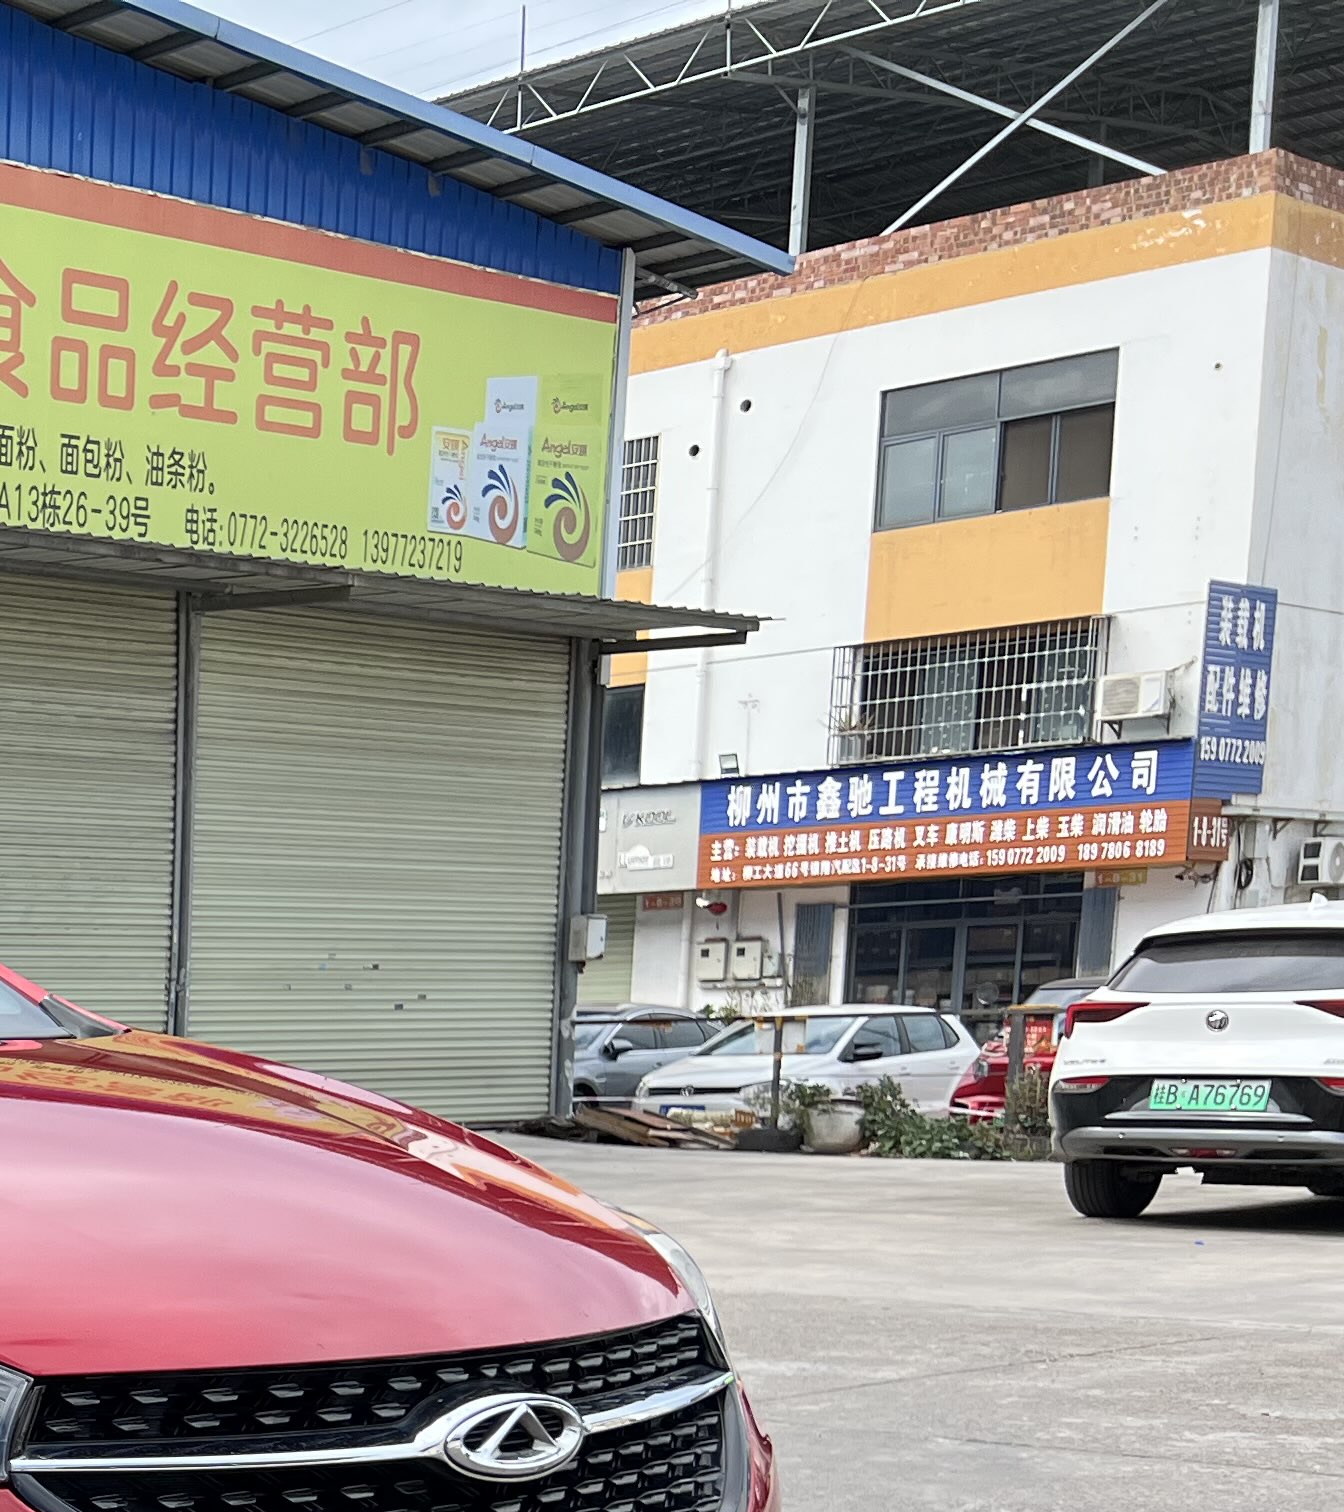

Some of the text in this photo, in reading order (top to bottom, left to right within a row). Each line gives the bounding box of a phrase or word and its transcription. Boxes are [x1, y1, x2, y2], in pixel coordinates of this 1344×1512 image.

[362, 528, 463, 574] 13977237219
[1218, 594, 1267, 651] 装载机
[1204, 663, 1267, 721] 配件维修
[726, 750, 1158, 827] 柳州市鑫驰工程机械有限公司
[824, 829, 862, 854] 推土机
[867, 826, 907, 851] 压路机
[912, 823, 940, 847] 叉车
[1021, 815, 1050, 840] 上柴
[1056, 813, 1084, 838] 玉柴
[1091, 810, 1134, 836] 润滑油
[1138, 807, 1168, 834] 轮胎
[1007, 846, 1033, 866] 0772
[1035, 844, 1066, 864] 2009
[1077, 842, 1098, 861] 189
[1101, 840, 1131, 860] 7806
[1135, 838, 1165, 858] 8189
